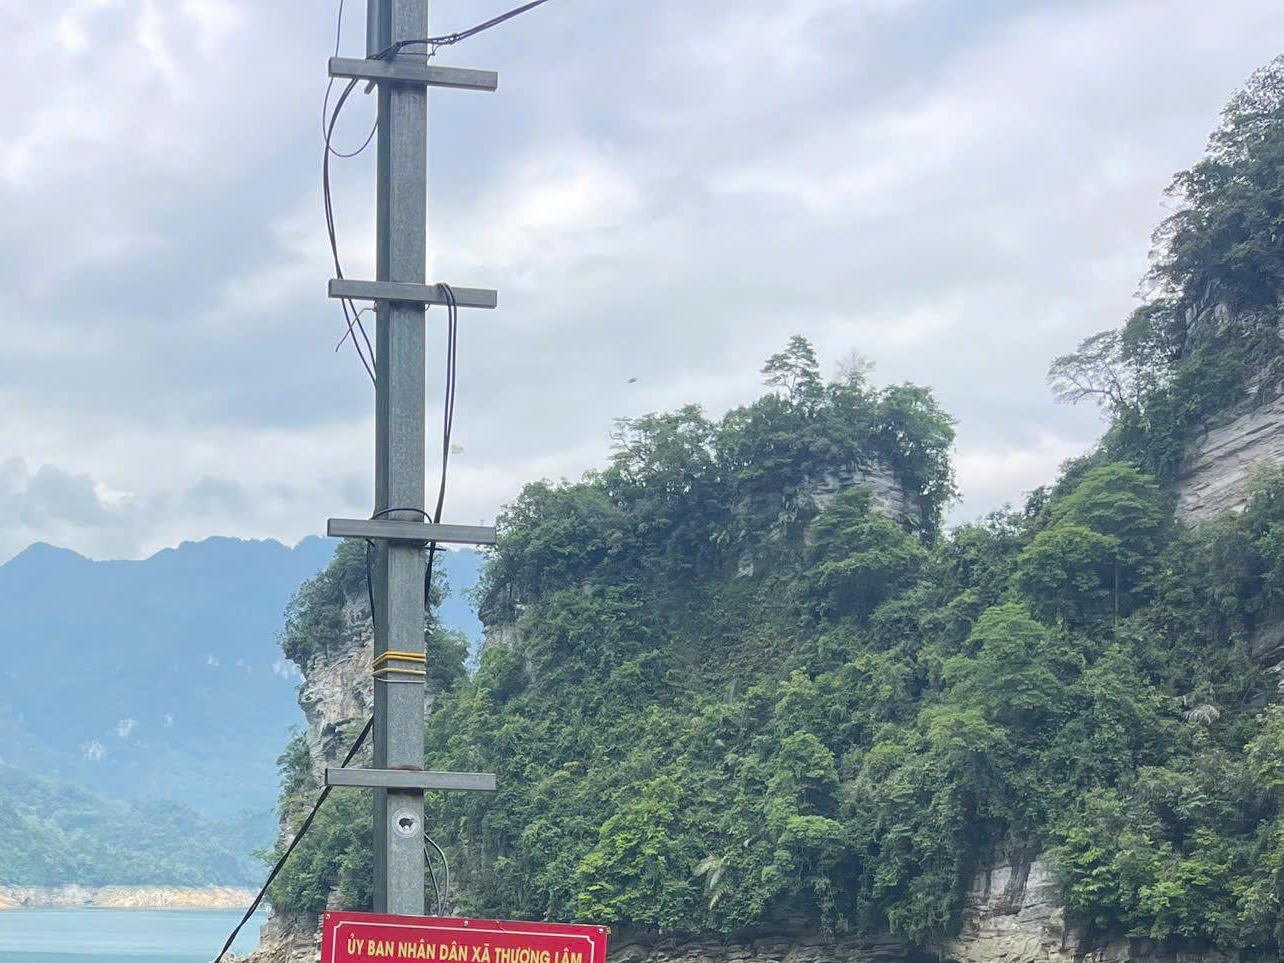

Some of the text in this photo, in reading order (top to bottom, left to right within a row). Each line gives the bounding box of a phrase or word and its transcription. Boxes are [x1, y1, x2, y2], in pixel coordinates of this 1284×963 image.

[347, 933, 364, 955] ỦY
[367, 940, 394, 957] BAN
[398, 939, 436, 960] NHÂN
[439, 942, 468, 962] DÂN
[471, 943, 491, 963] XÃ
